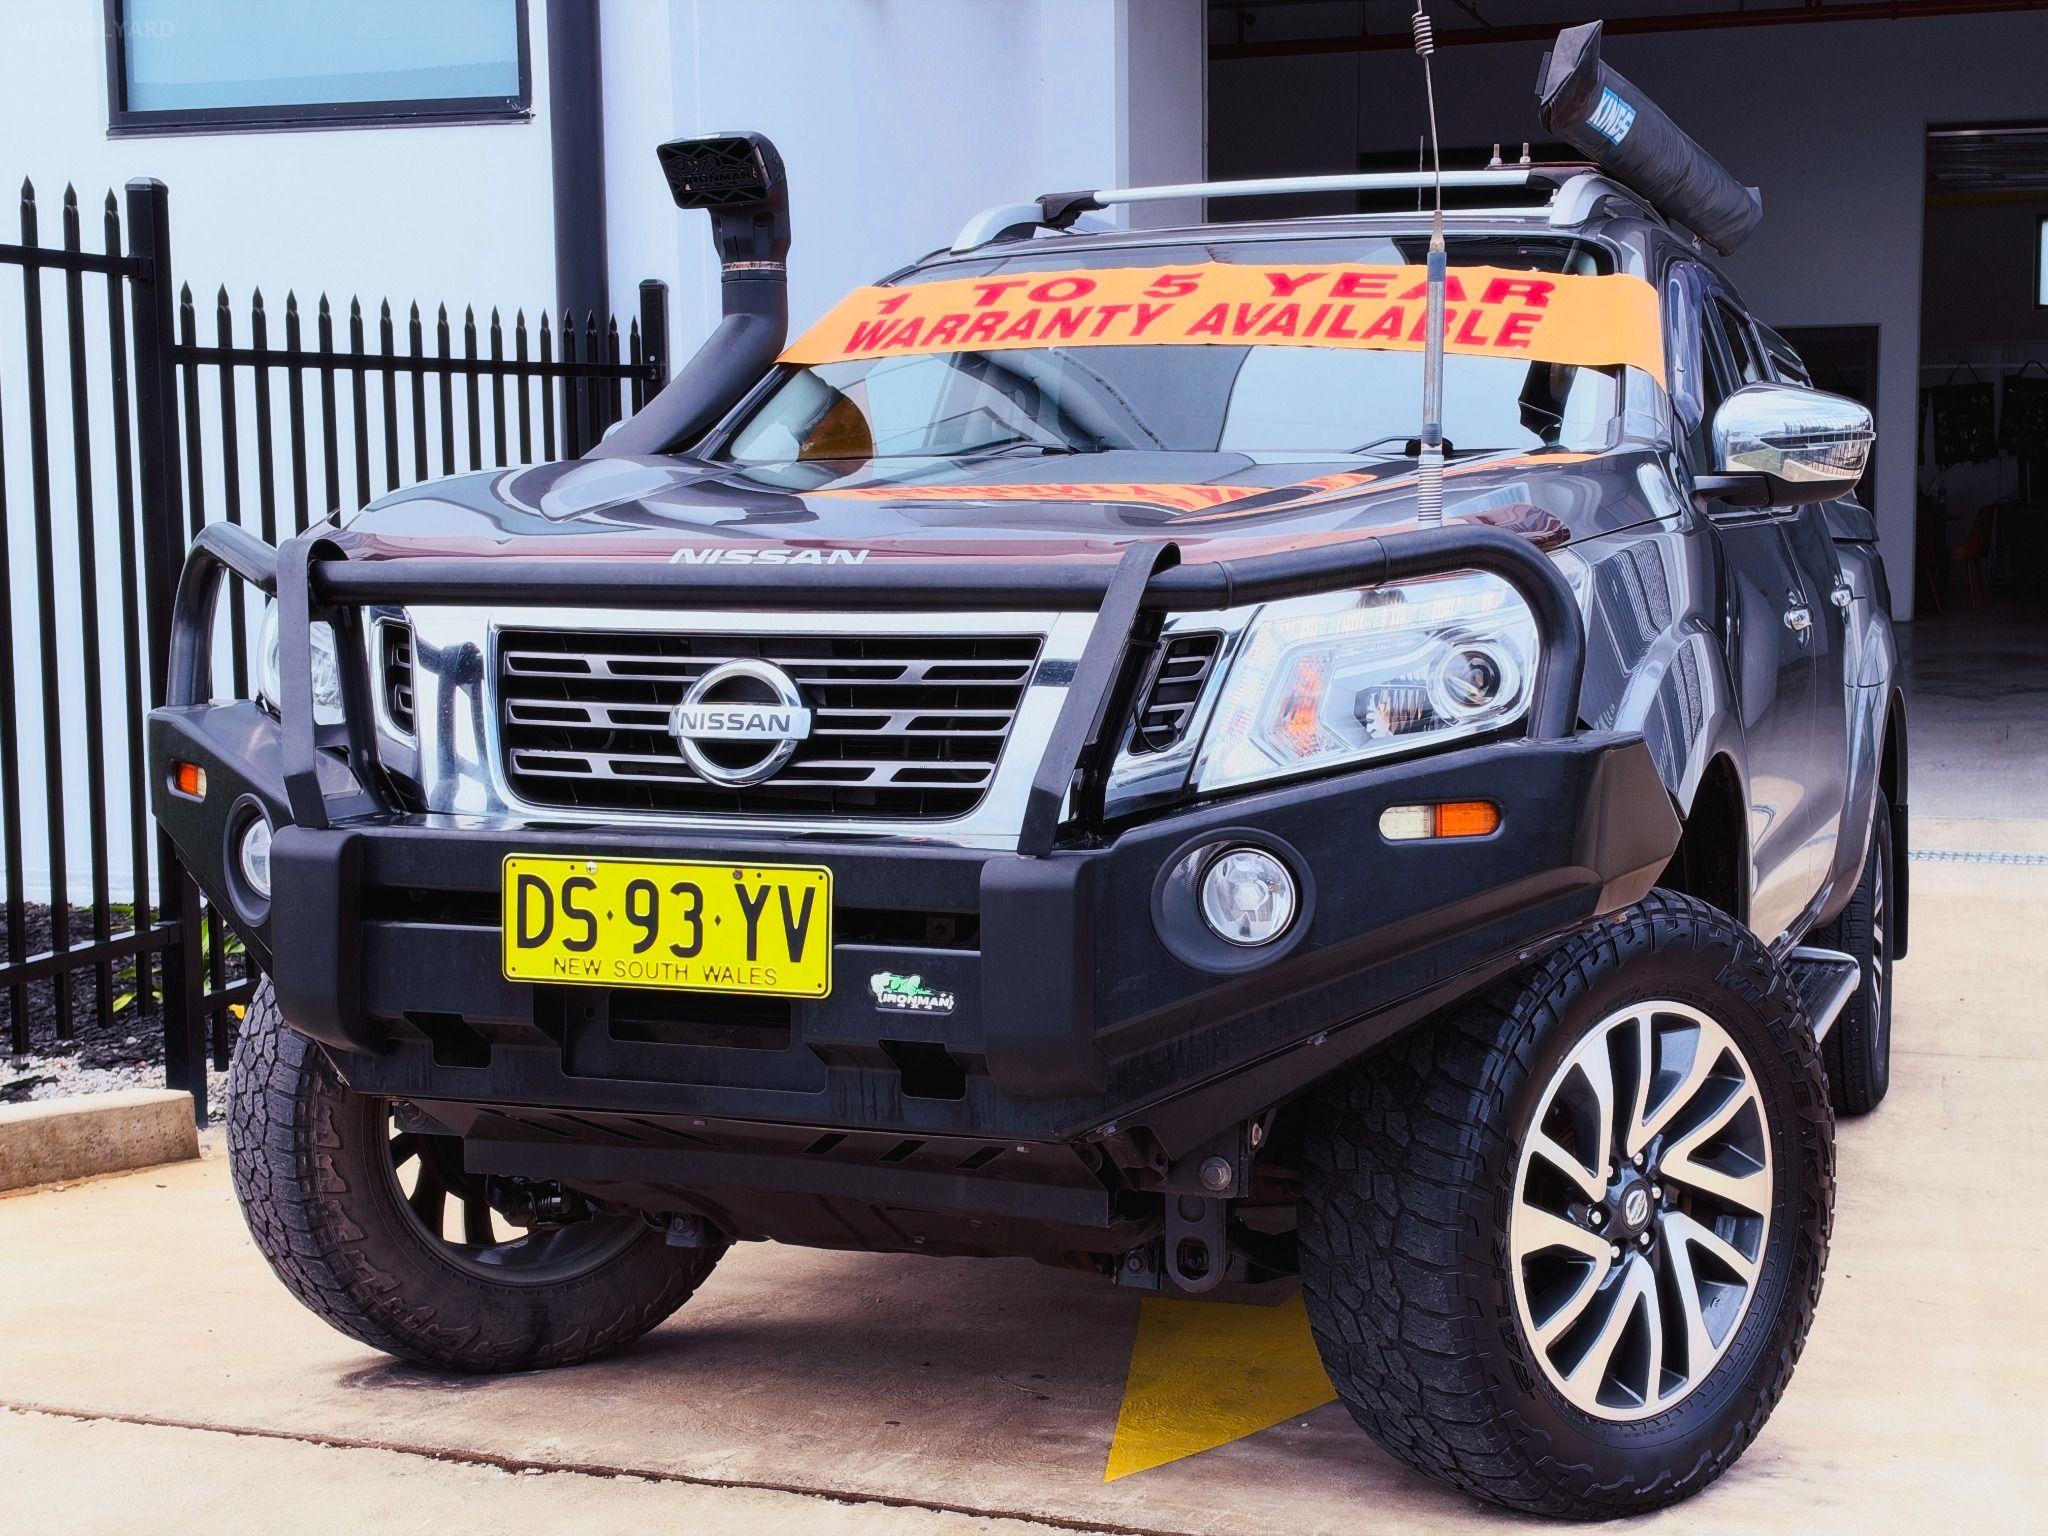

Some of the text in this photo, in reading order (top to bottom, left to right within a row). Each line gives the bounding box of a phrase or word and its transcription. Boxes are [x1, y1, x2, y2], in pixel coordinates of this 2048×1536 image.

[1586, 91, 1635, 144] KINGS
[877, 272, 1556, 314] 1 TO 5 YEAR
[843, 302, 1543, 354] WARRANTY AVAILABLE
[668, 548, 870, 565] NISSAN
[680, 712, 791, 733] NISSAN
[553, 957, 778, 986] NEW SOUTH WALES
[882, 993, 950, 1007] IRONMAN
